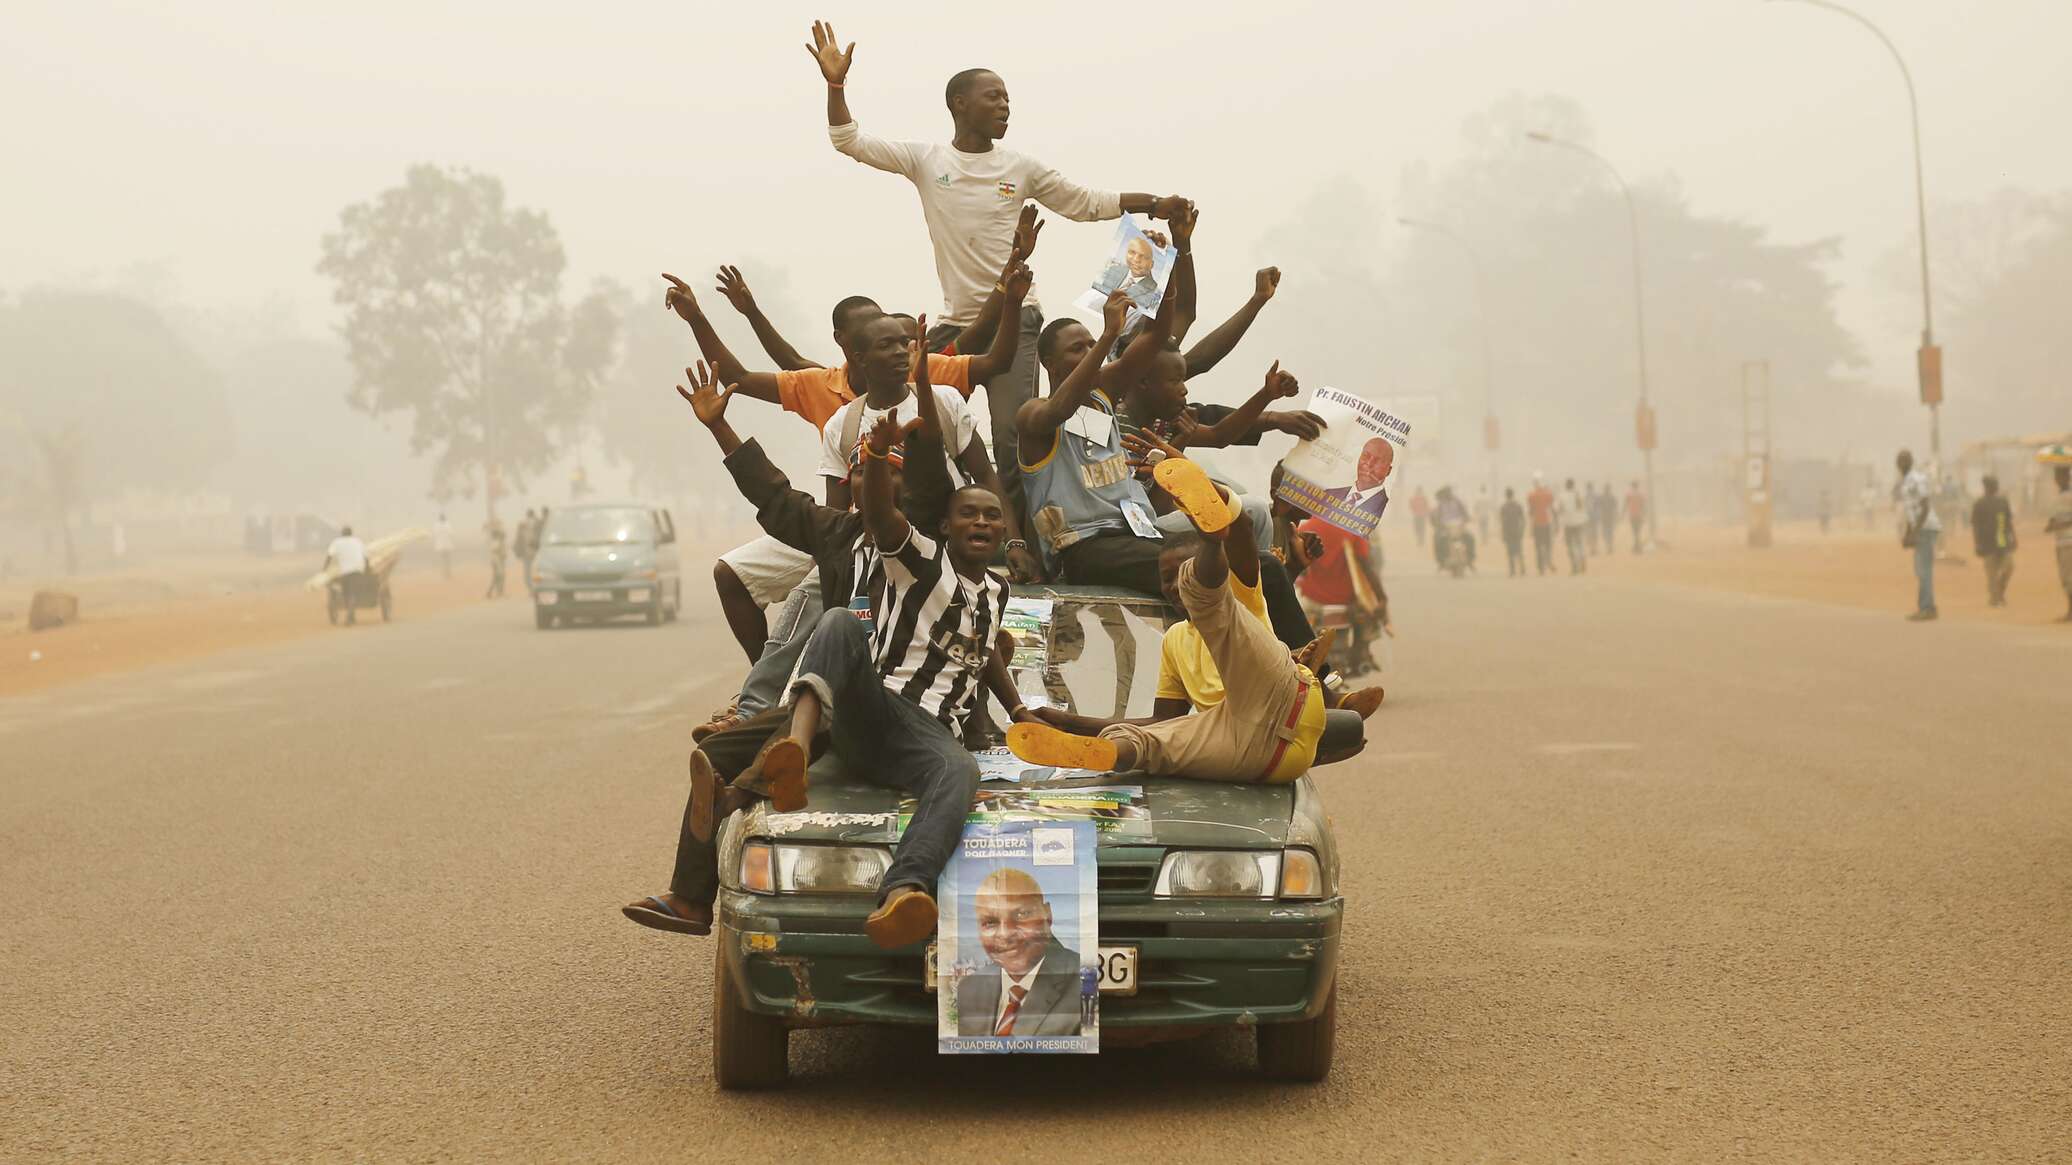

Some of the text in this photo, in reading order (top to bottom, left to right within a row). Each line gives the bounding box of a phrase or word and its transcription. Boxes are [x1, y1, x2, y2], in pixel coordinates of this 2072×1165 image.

[1316, 388, 1329, 400] Pr.
[1331, 392, 1372, 416] FAUSTIN
[1355, 415, 1377, 432] Notre
[1280, 486, 1328, 515] CANDIDAT
[963, 838, 1028, 849] TOUADERA
[949, 1040, 1088, 1050] TOUADERA MON PRESIDENT
